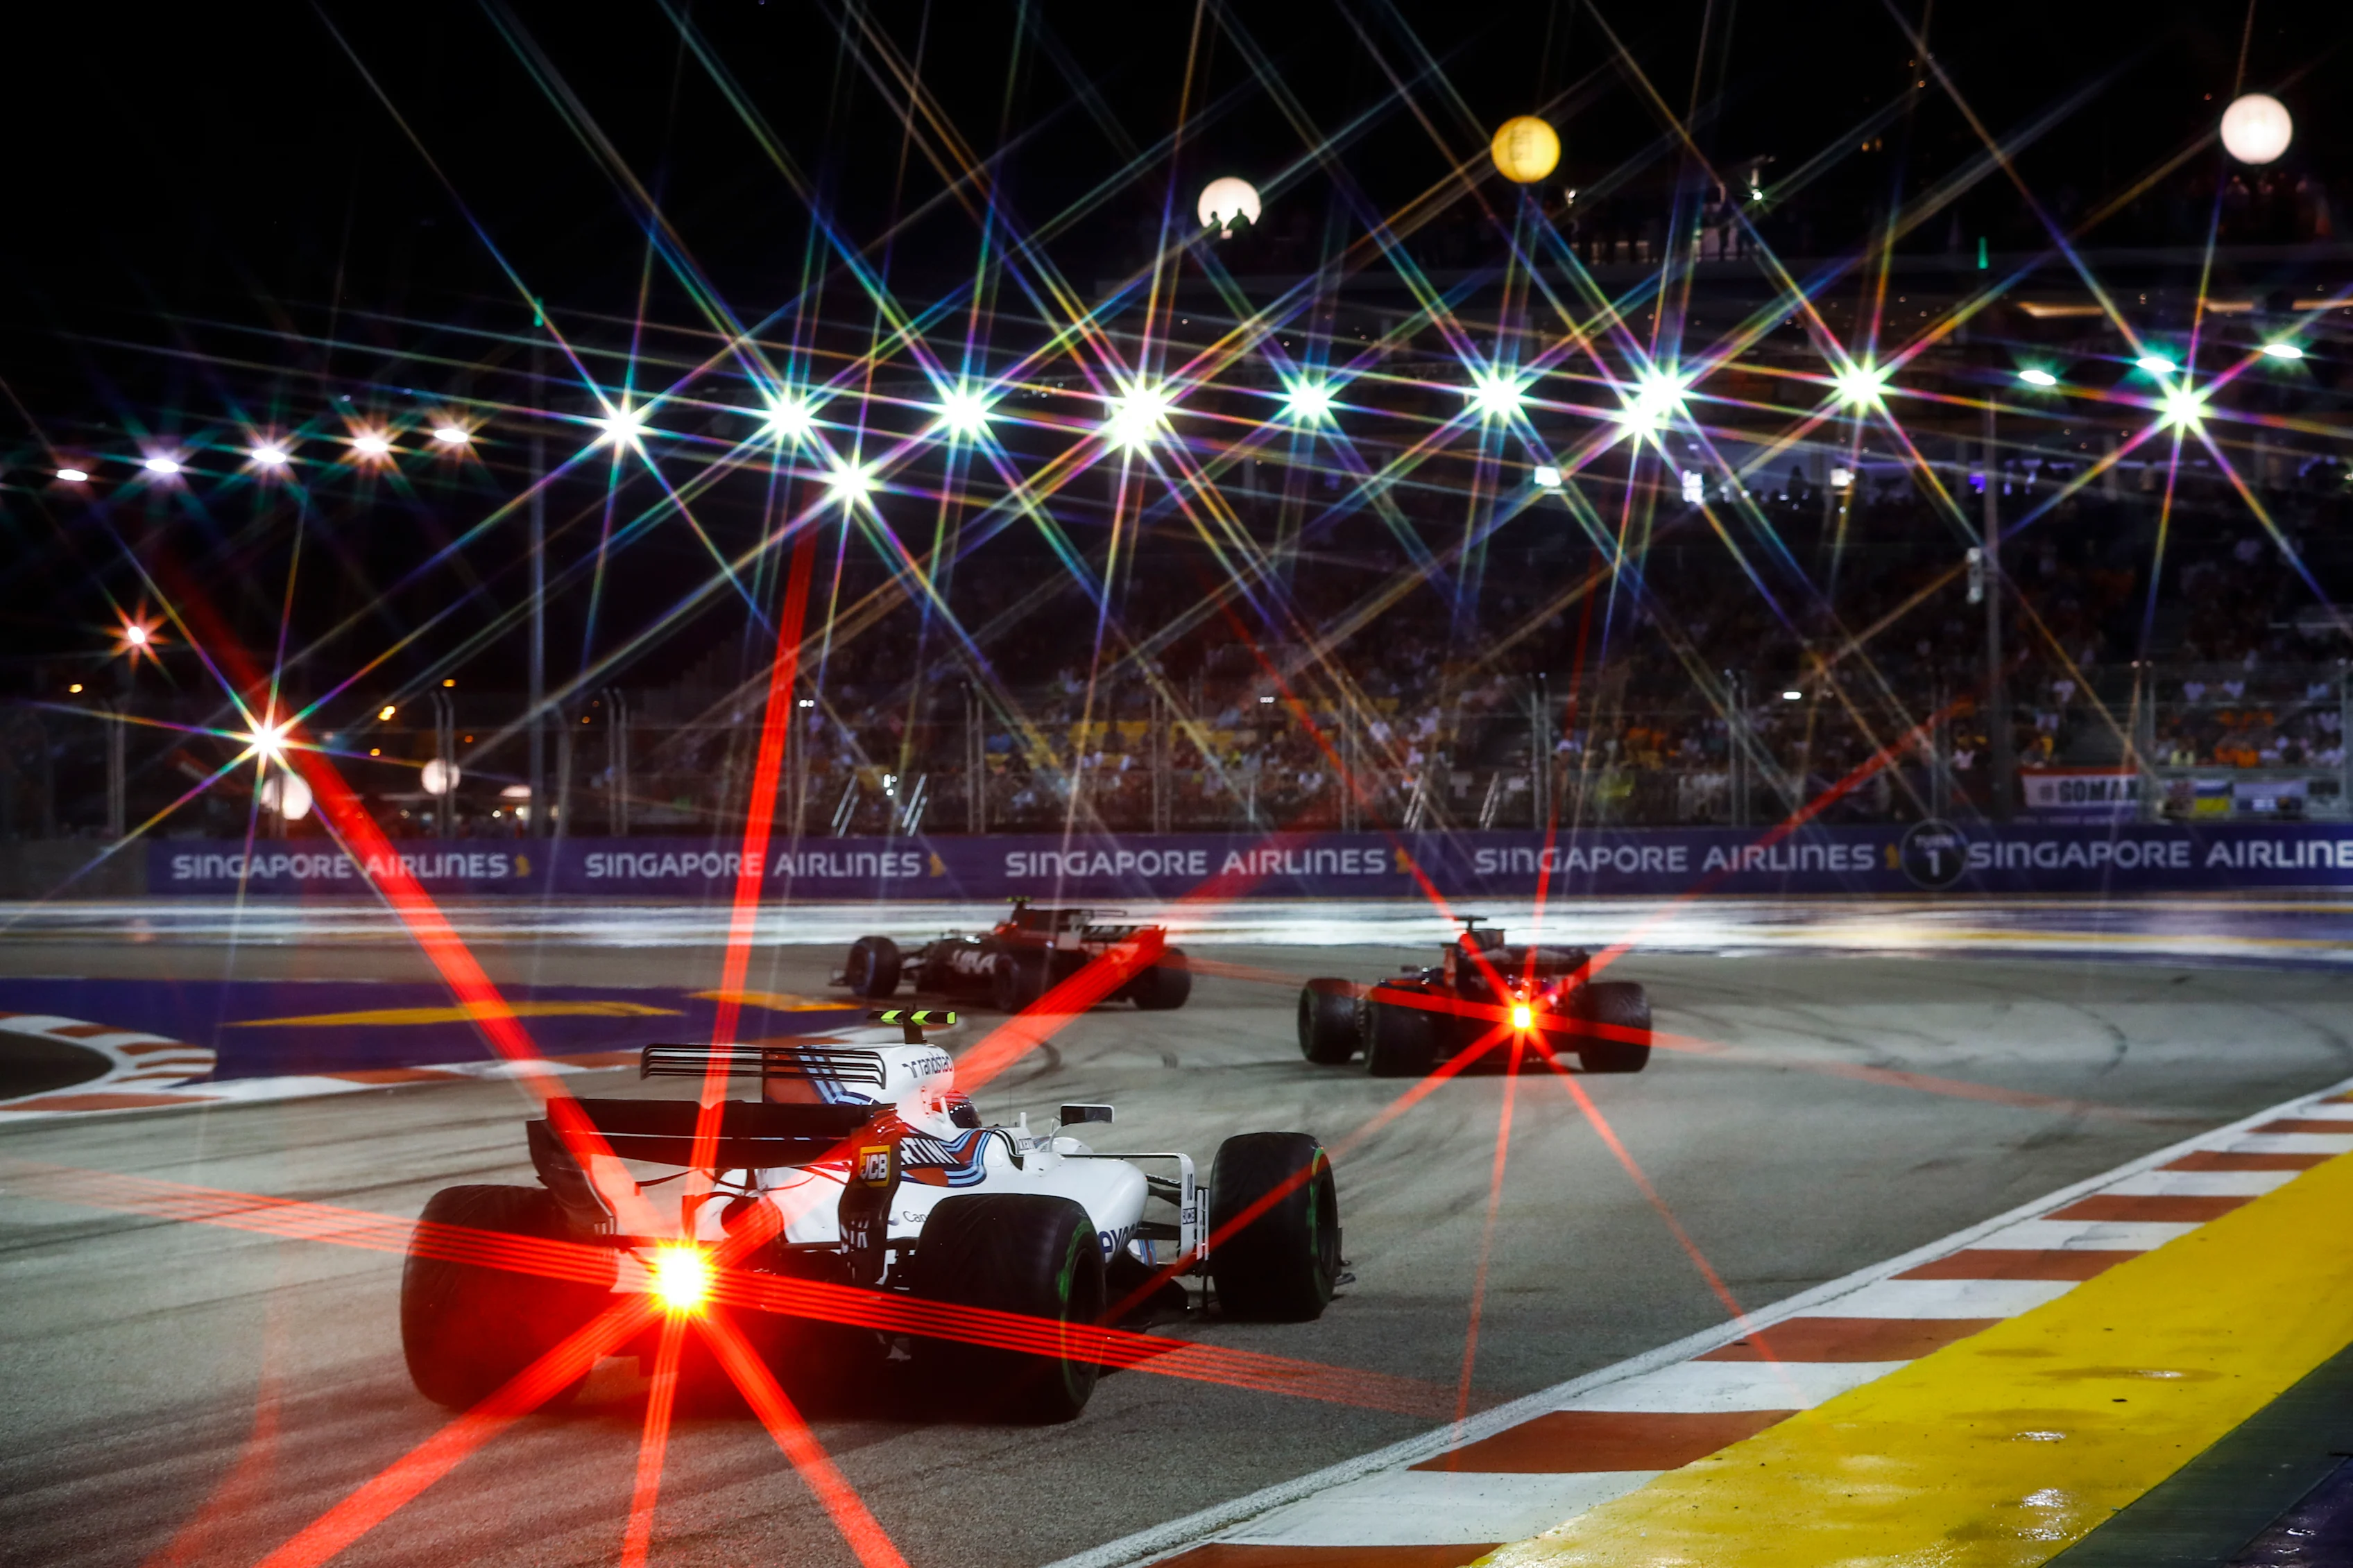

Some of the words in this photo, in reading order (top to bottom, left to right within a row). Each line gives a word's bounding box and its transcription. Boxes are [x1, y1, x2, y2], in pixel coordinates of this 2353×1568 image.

[171, 854, 351, 879] SINGAPORE
[366, 854, 508, 879] AIRLINES
[585, 853, 762, 877] SINGAPORE
[773, 852, 921, 877] AIRLINES
[1005, 850, 1207, 877] SINGAPORE
[1222, 849, 1386, 875] AIRLINES
[1474, 845, 1688, 874] SINGAPORE
[1702, 845, 1874, 871] AIRLINES
[1926, 850, 1941, 877] 1
[1969, 841, 2190, 868] SINGAPORE
[861, 1154, 888, 1180] JCB
